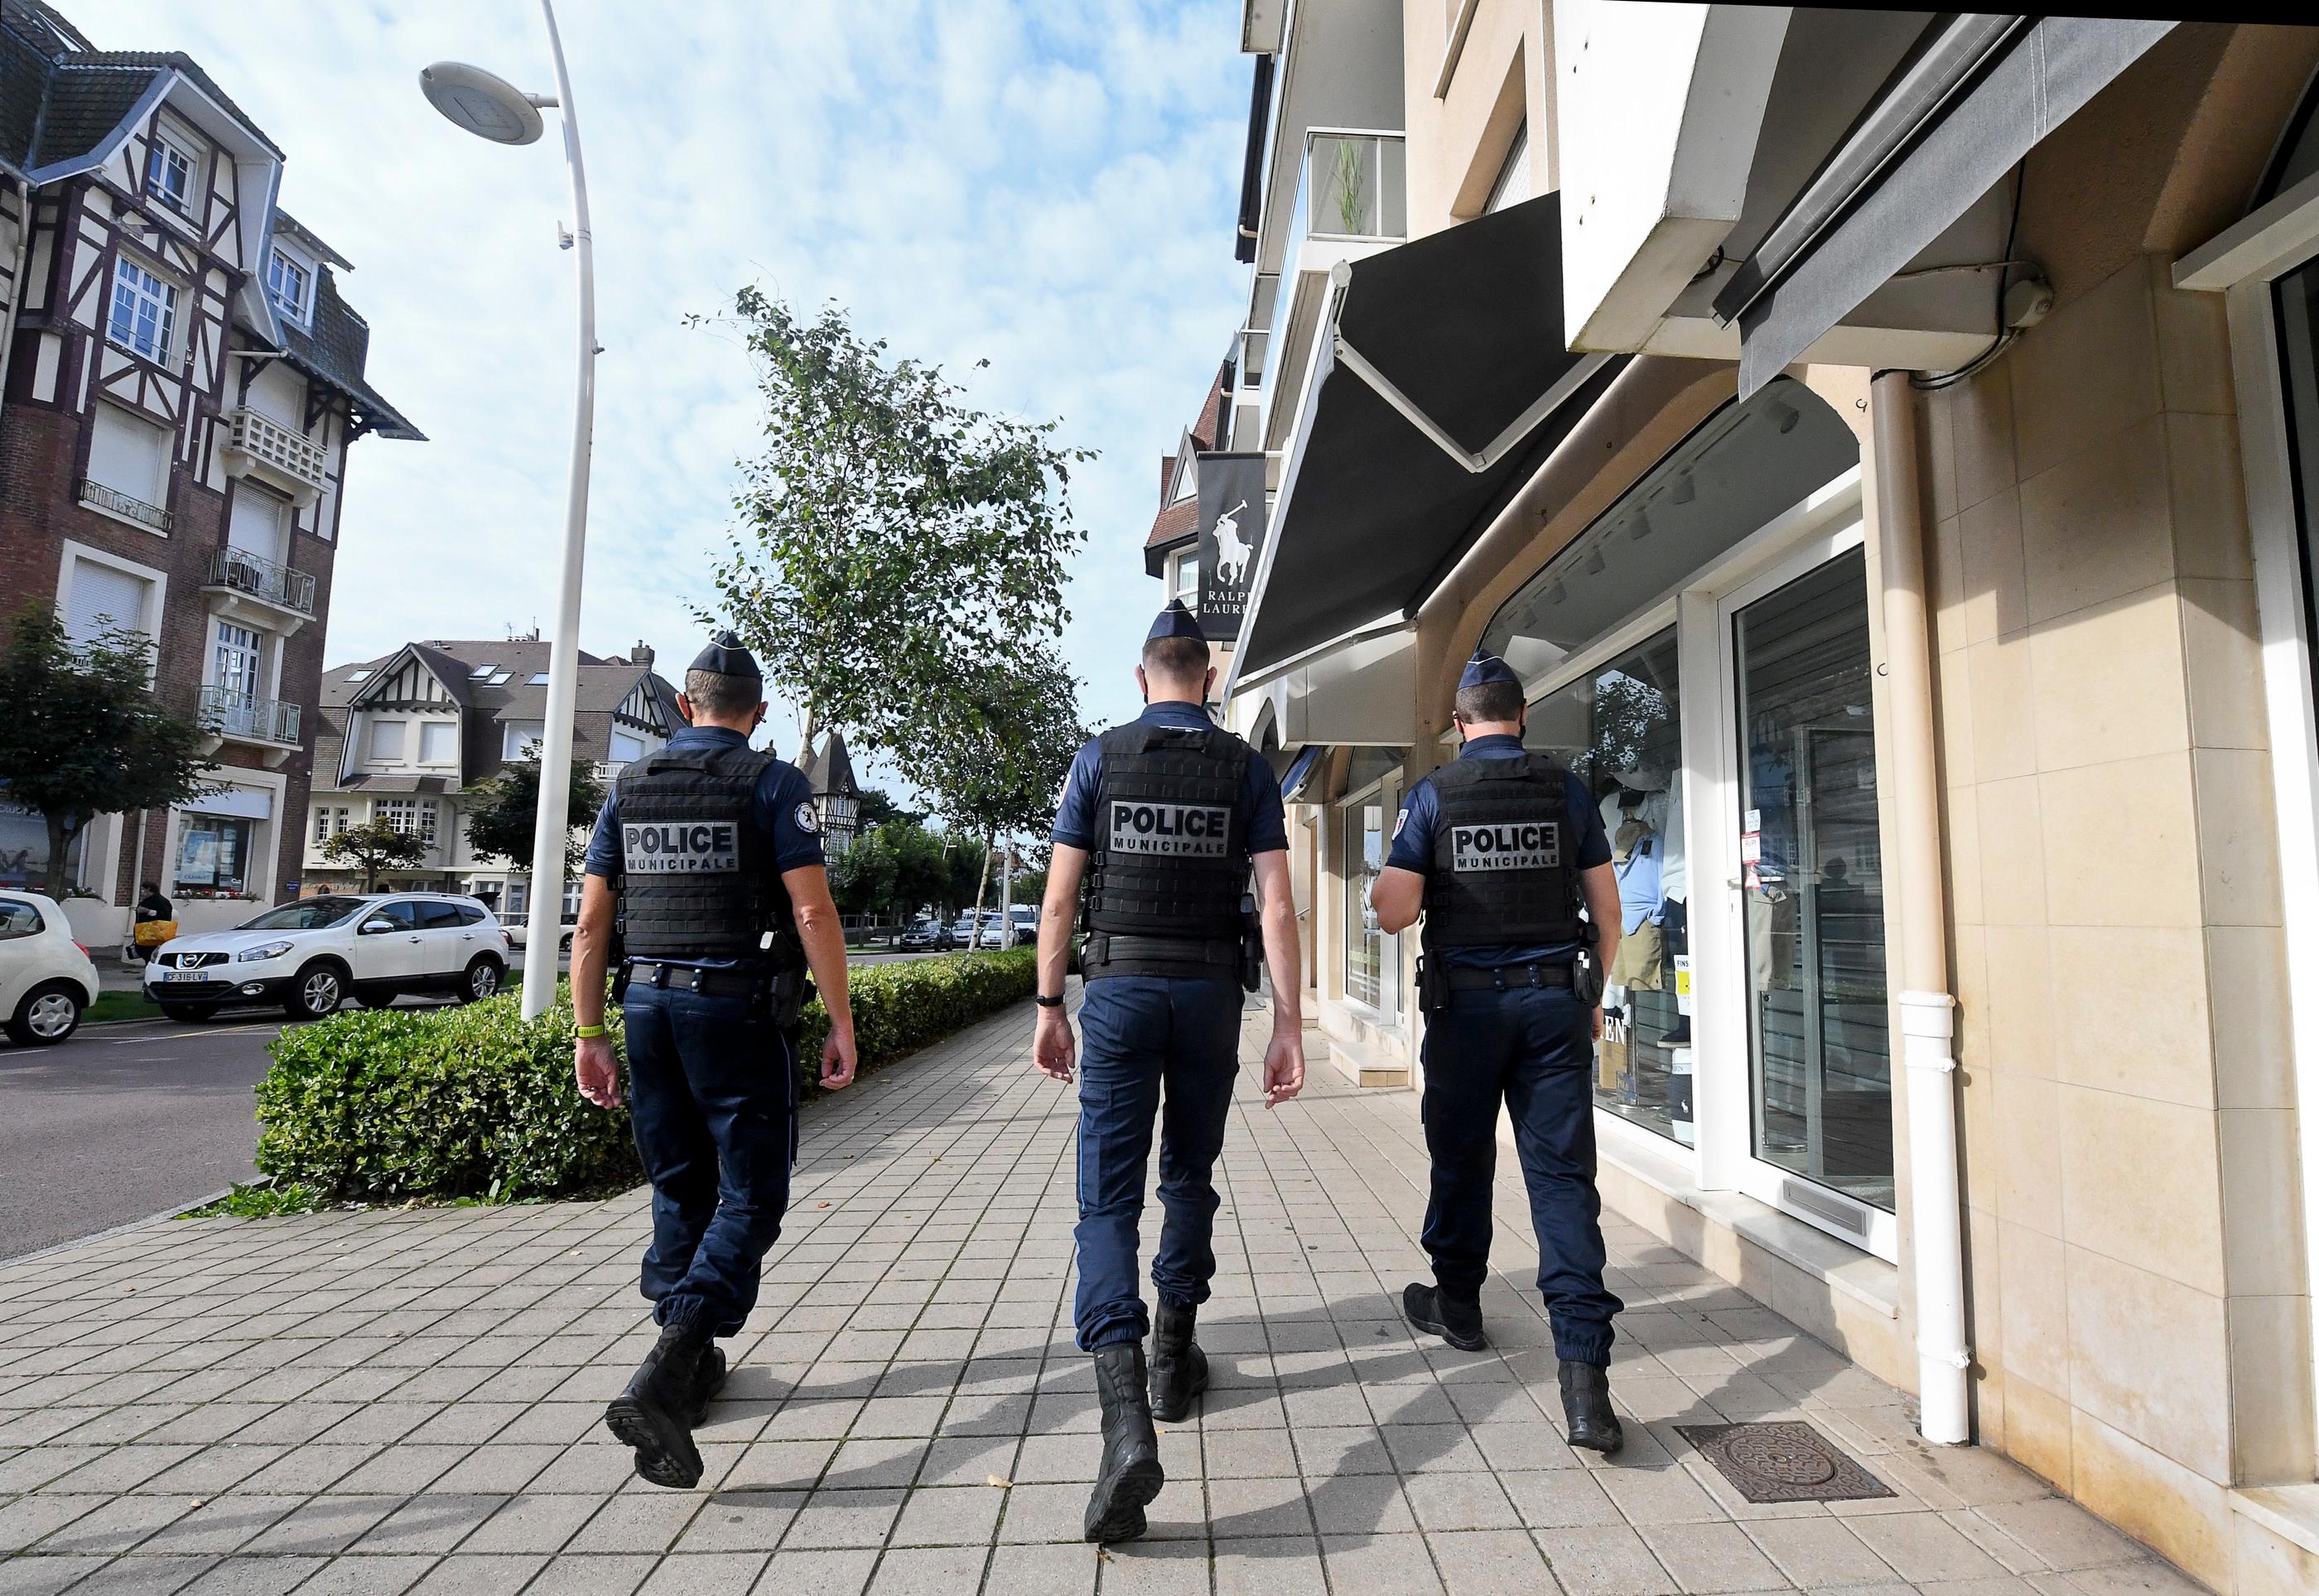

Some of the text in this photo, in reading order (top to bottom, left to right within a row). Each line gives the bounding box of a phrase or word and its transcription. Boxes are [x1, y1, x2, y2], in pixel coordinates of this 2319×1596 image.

[1114, 806, 1226, 837] POLICE
[626, 827, 732, 854] POLICE
[1114, 837, 1225, 854] MUNICIPALE
[1456, 827, 1555, 854] POLICE
[628, 858, 735, 870] MUNICIPALE
[1458, 855, 1558, 868] MUNICIPALE
